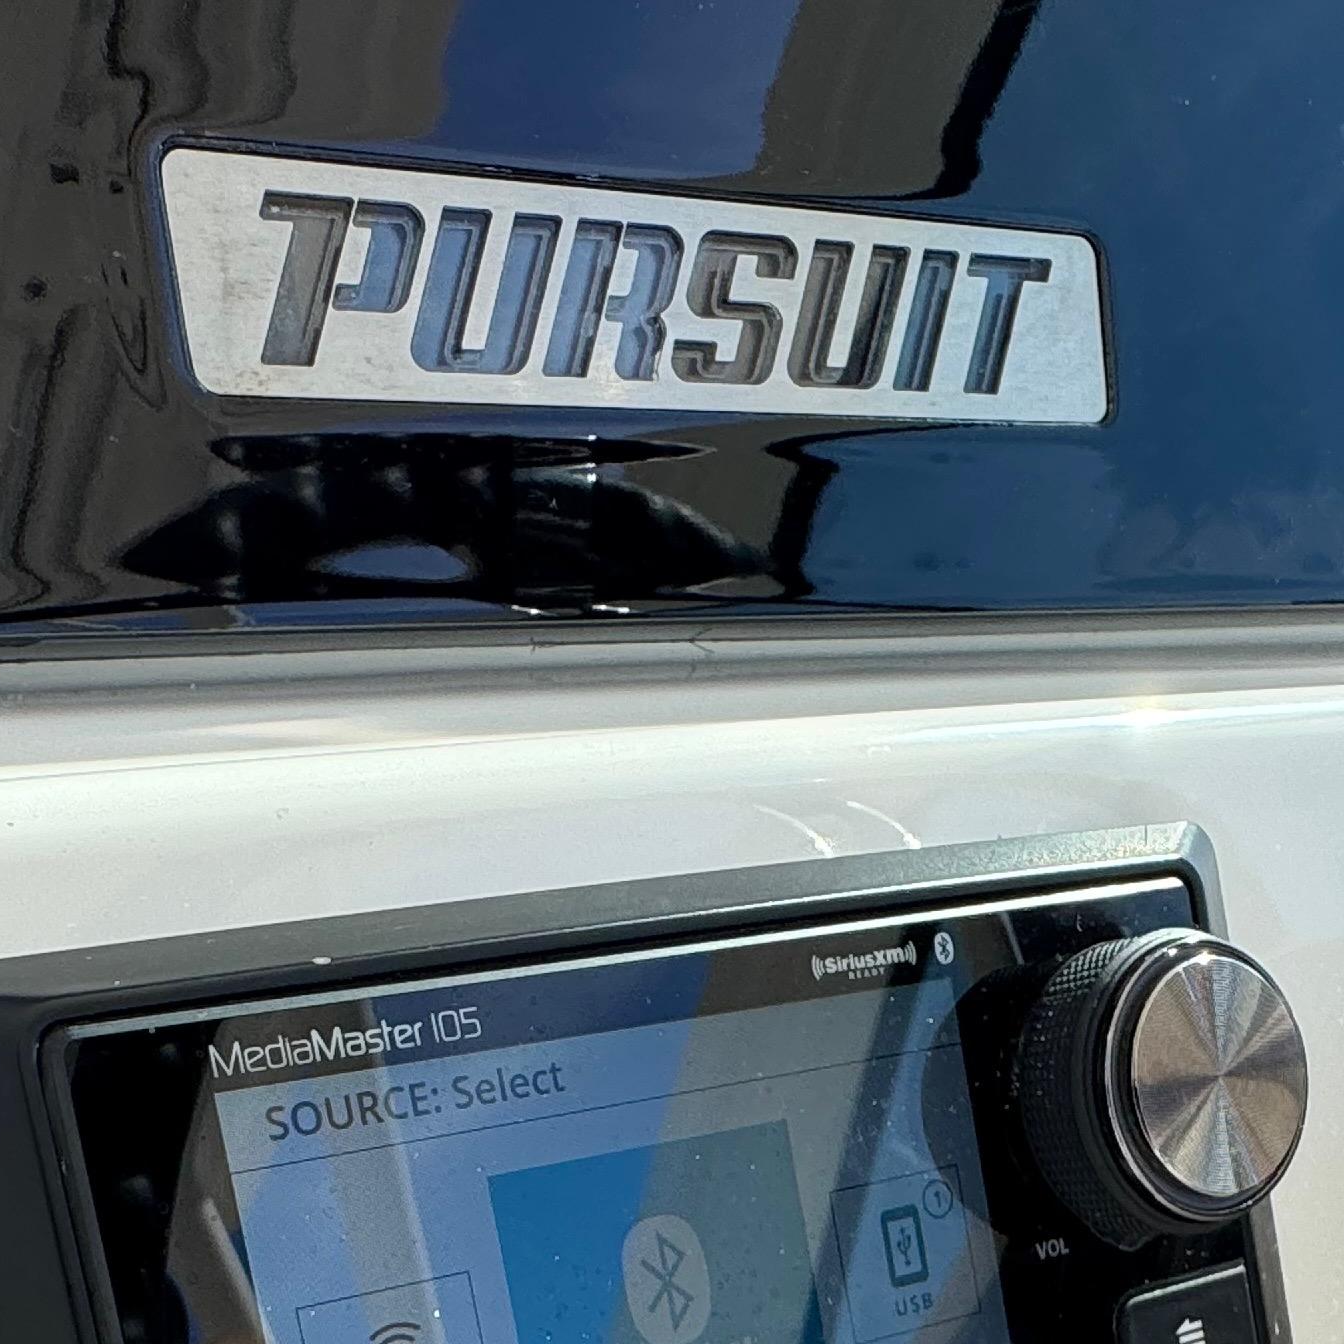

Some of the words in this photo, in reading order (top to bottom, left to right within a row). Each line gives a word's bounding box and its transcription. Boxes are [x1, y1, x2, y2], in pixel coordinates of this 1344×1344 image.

[258, 190, 1052, 396] PURSUIT
[848, 967, 886, 981] READY
[208, 1020, 423, 1078] MediaMaster
[265, 1080, 443, 1142] SOURCE:
[451, 1062, 566, 1110] Select
[1035, 1237, 1069, 1260] VOL
[893, 1291, 934, 1317] USB
